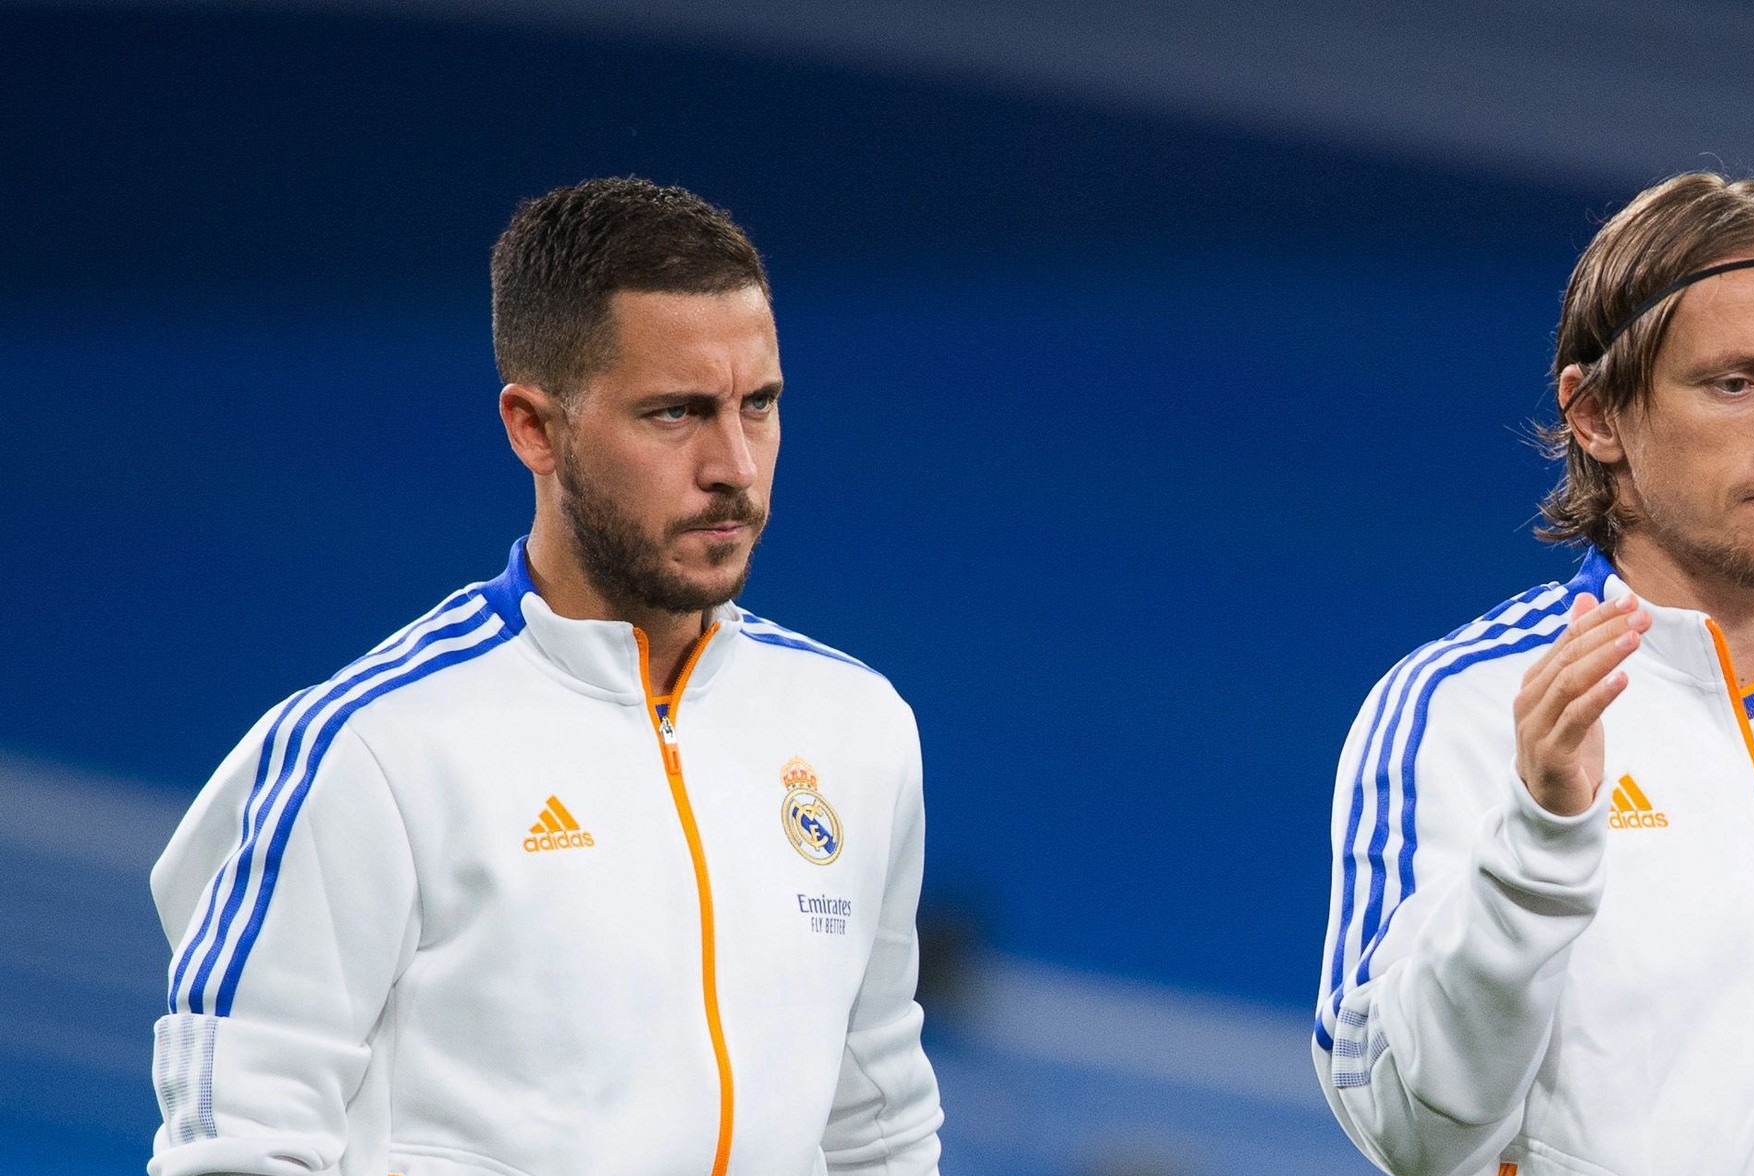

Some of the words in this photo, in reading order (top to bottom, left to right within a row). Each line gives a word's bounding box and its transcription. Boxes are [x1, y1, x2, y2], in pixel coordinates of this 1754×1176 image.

[1607, 805, 1669, 829] didas
[523, 831, 595, 853] adidas
[797, 893, 852, 917] Emirates
[811, 916, 823, 933] FLY
[825, 917, 846, 935] BETTER
